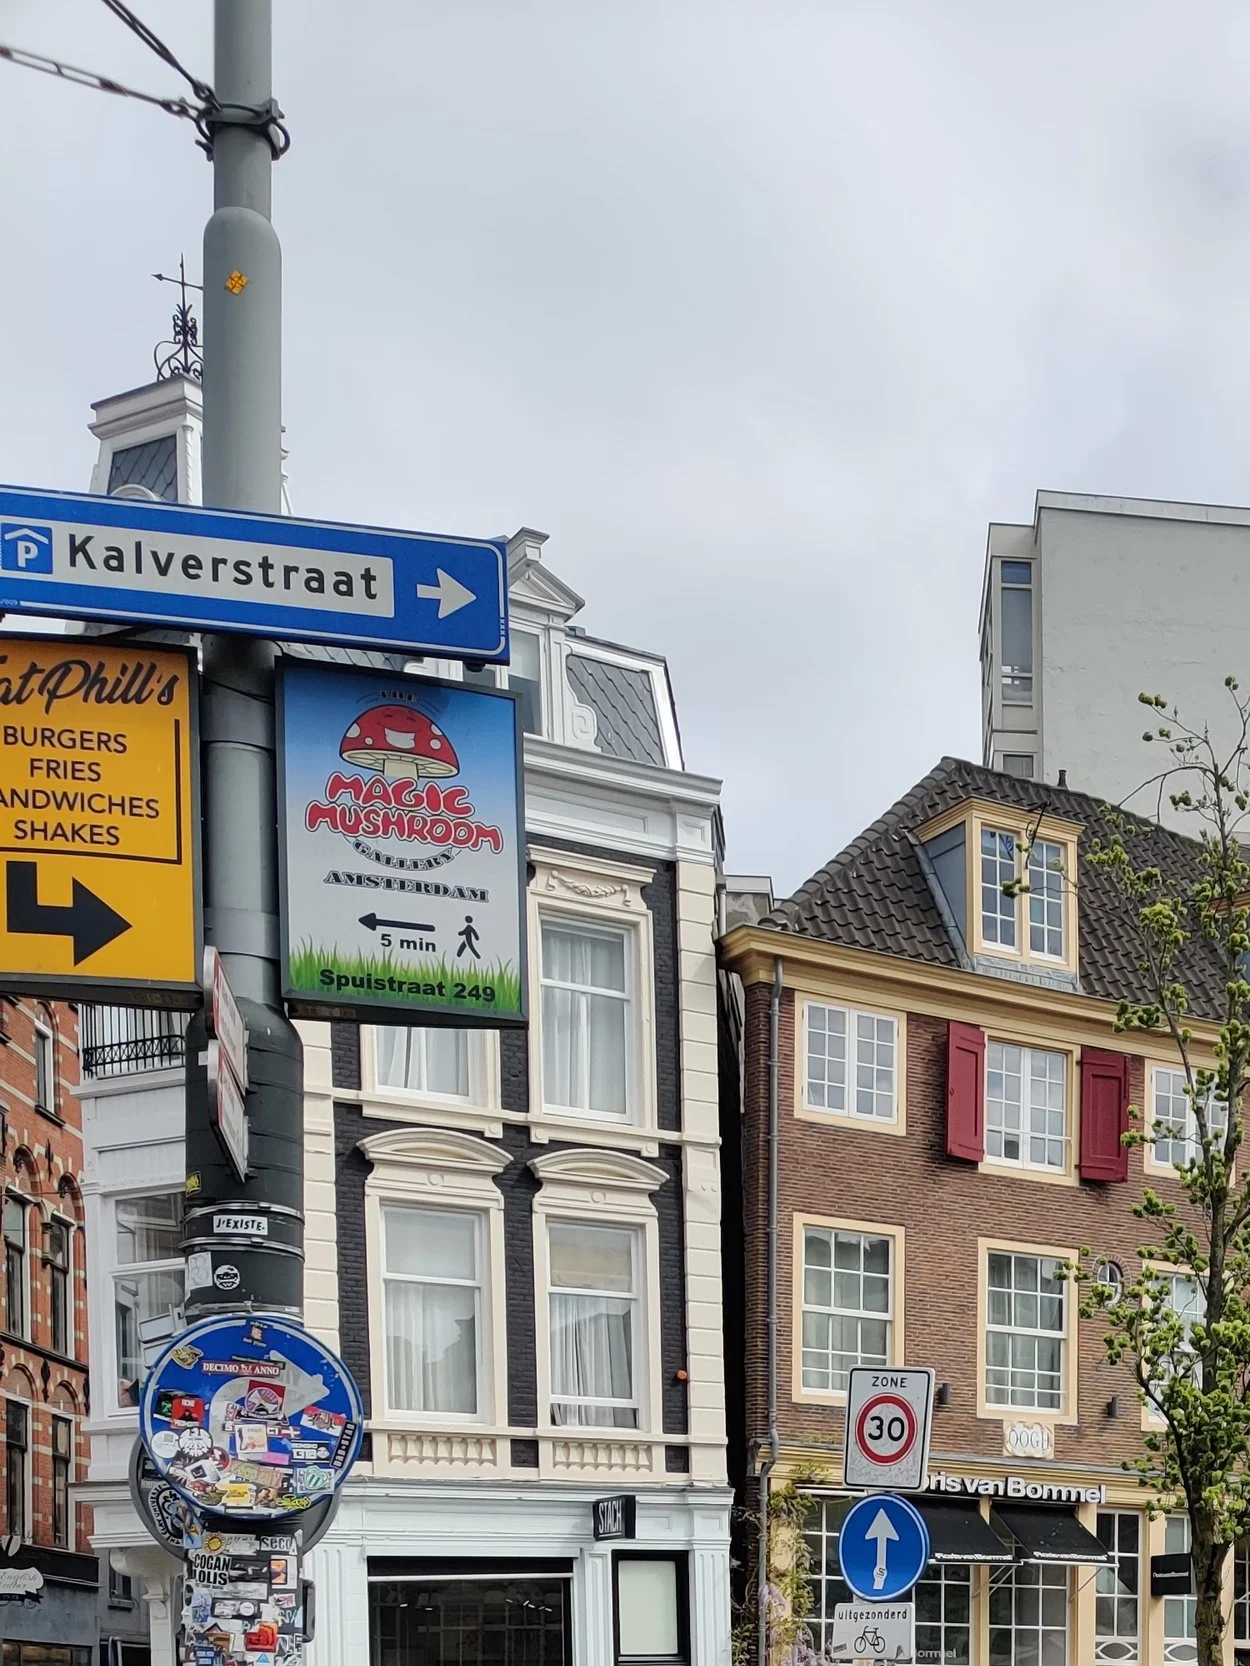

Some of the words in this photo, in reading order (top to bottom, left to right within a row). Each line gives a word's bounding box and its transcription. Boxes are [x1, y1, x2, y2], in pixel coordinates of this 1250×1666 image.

[68, 533, 378, 600] Kalverstraat
[38, 659, 180, 715] Phill's
[3, 725, 128, 754] BURGERS
[30, 758, 101, 782] FRIES
[327, 771, 475, 817] MAGIC
[14, 819, 120, 846] SHAKES
[306, 800, 503, 853] MUSHROOM
[352, 839, 454, 871] GALLERY
[323, 870, 489, 903] AMSTERDAM
[380, 934, 392, 948] 5
[400, 937, 437, 952] min
[320, 969, 446, 998] Spuistraat
[453, 982, 496, 1002] 249
[203, 1362, 239, 1373] DECIMO
[254, 1366, 280, 1376] ANNO
[872, 1376, 907, 1387] ZONE
[868, 1415, 905, 1441] 30
[962, 1477, 1005, 1496] van
[1007, 1476, 1106, 1504] Bommel
[599, 1500, 622, 1533] STACH
[838, 1609, 907, 1622] uitgezonderd
